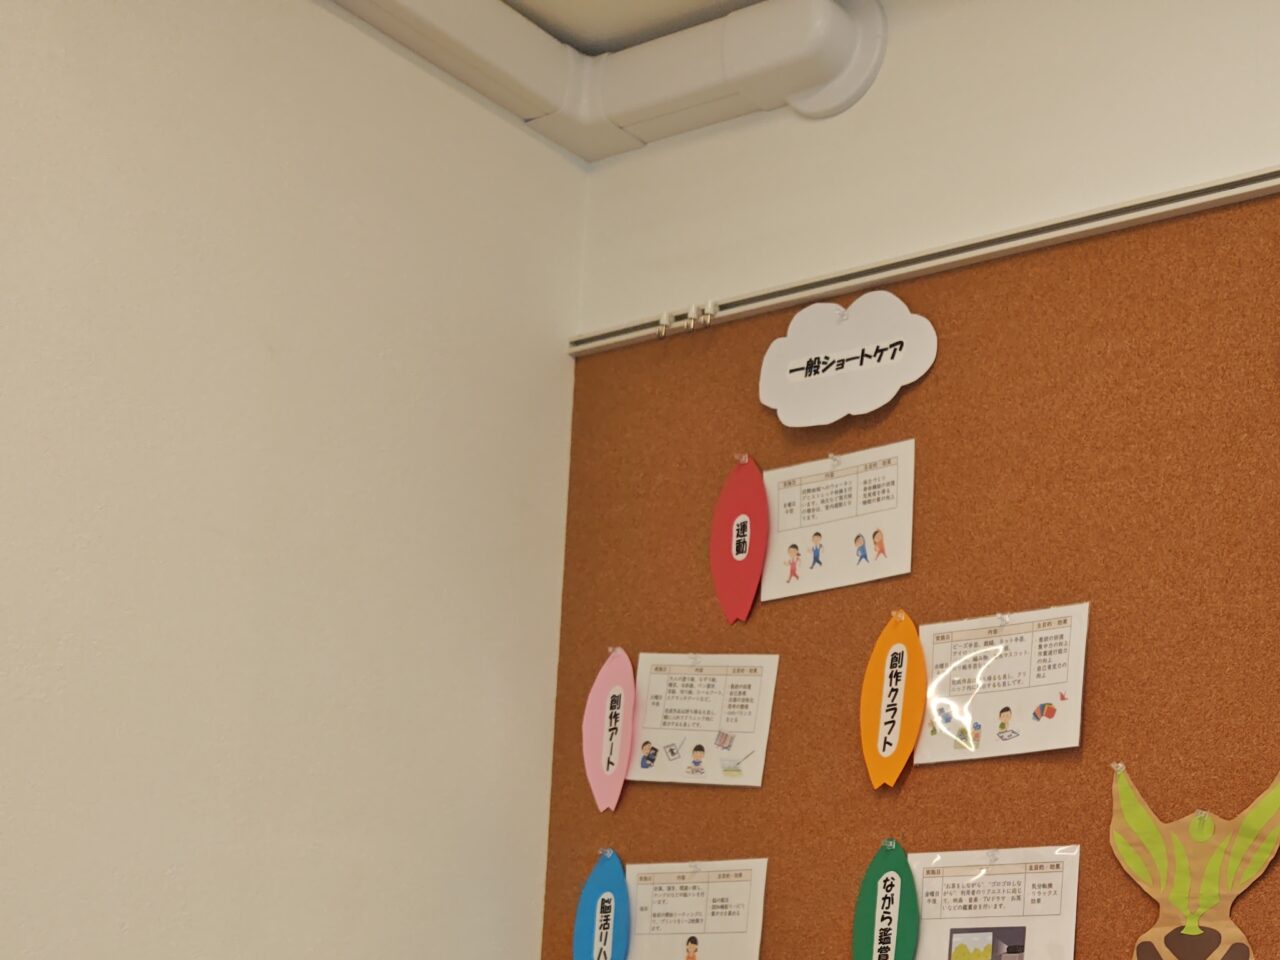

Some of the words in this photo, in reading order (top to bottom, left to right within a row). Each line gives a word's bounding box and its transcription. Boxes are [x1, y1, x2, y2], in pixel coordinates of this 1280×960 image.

[788, 340, 905, 378] 一般ショートケア
[735, 520, 749, 556] 運動
[882, 650, 904, 752] 創作クラフト
[606, 694, 622, 772] 創作アート
[597, 898, 612, 960] 脳活リハ
